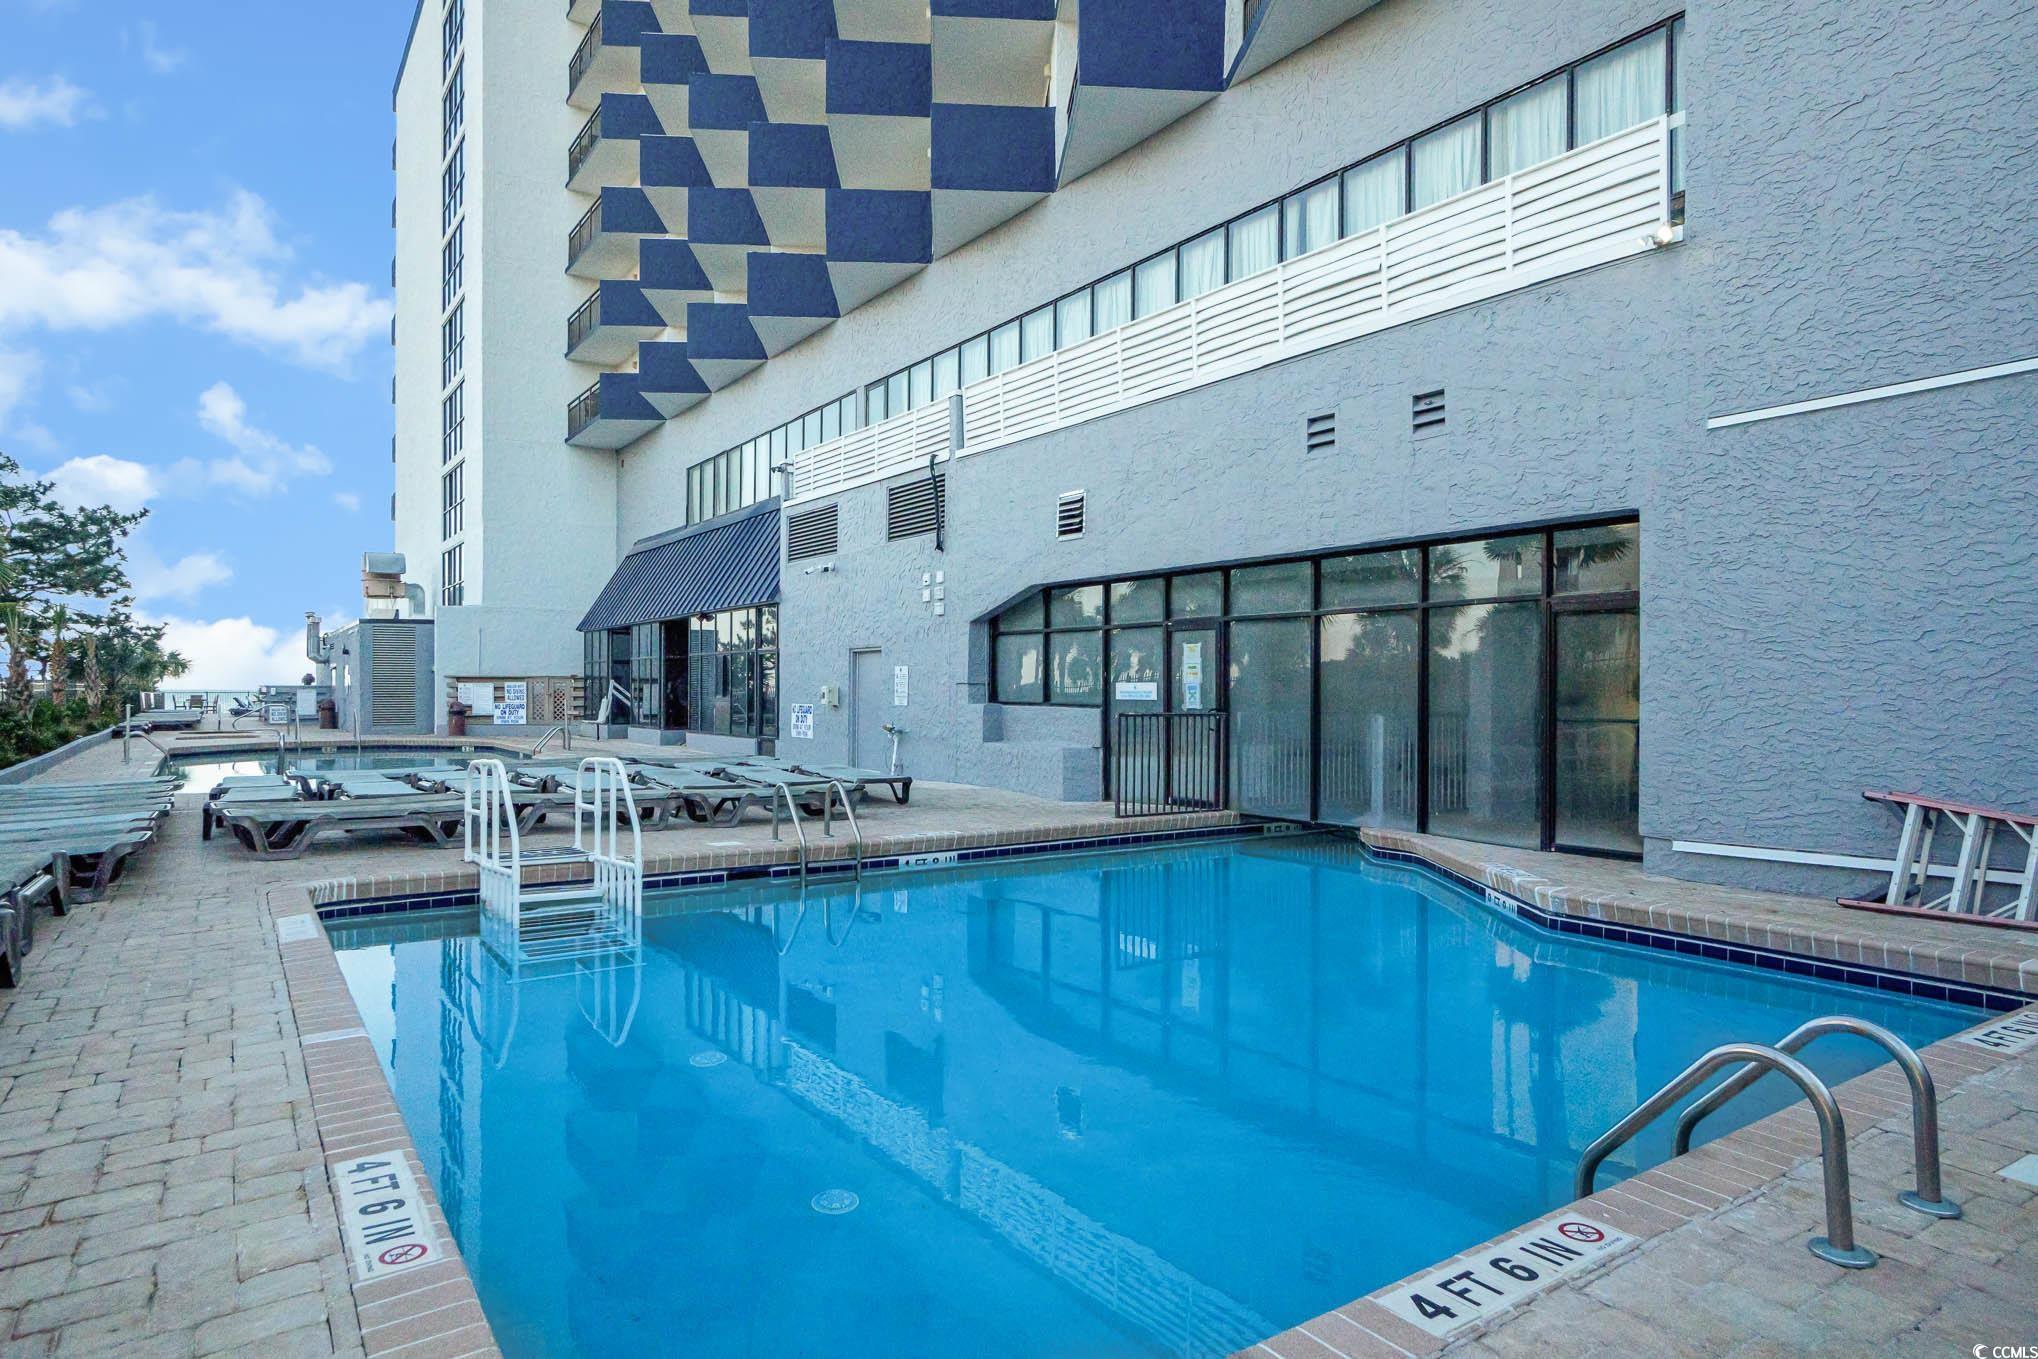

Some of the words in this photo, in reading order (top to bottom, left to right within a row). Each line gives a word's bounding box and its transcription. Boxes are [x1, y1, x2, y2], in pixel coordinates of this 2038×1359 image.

[1982, 1030, 2026, 1043] FT
[2000, 1026, 2037, 1035] 6
[1974, 1038, 2010, 1047] 4
[347, 1161, 392, 1174] 4
[350, 1173, 400, 1195] FT
[359, 1198, 406, 1215] 6
[361, 1217, 415, 1245] IN
[1409, 1293, 1458, 1319] 4
[1435, 1270, 1505, 1307] FT
[1489, 1257, 1539, 1281] 6
[1519, 1237, 1584, 1266] IN
